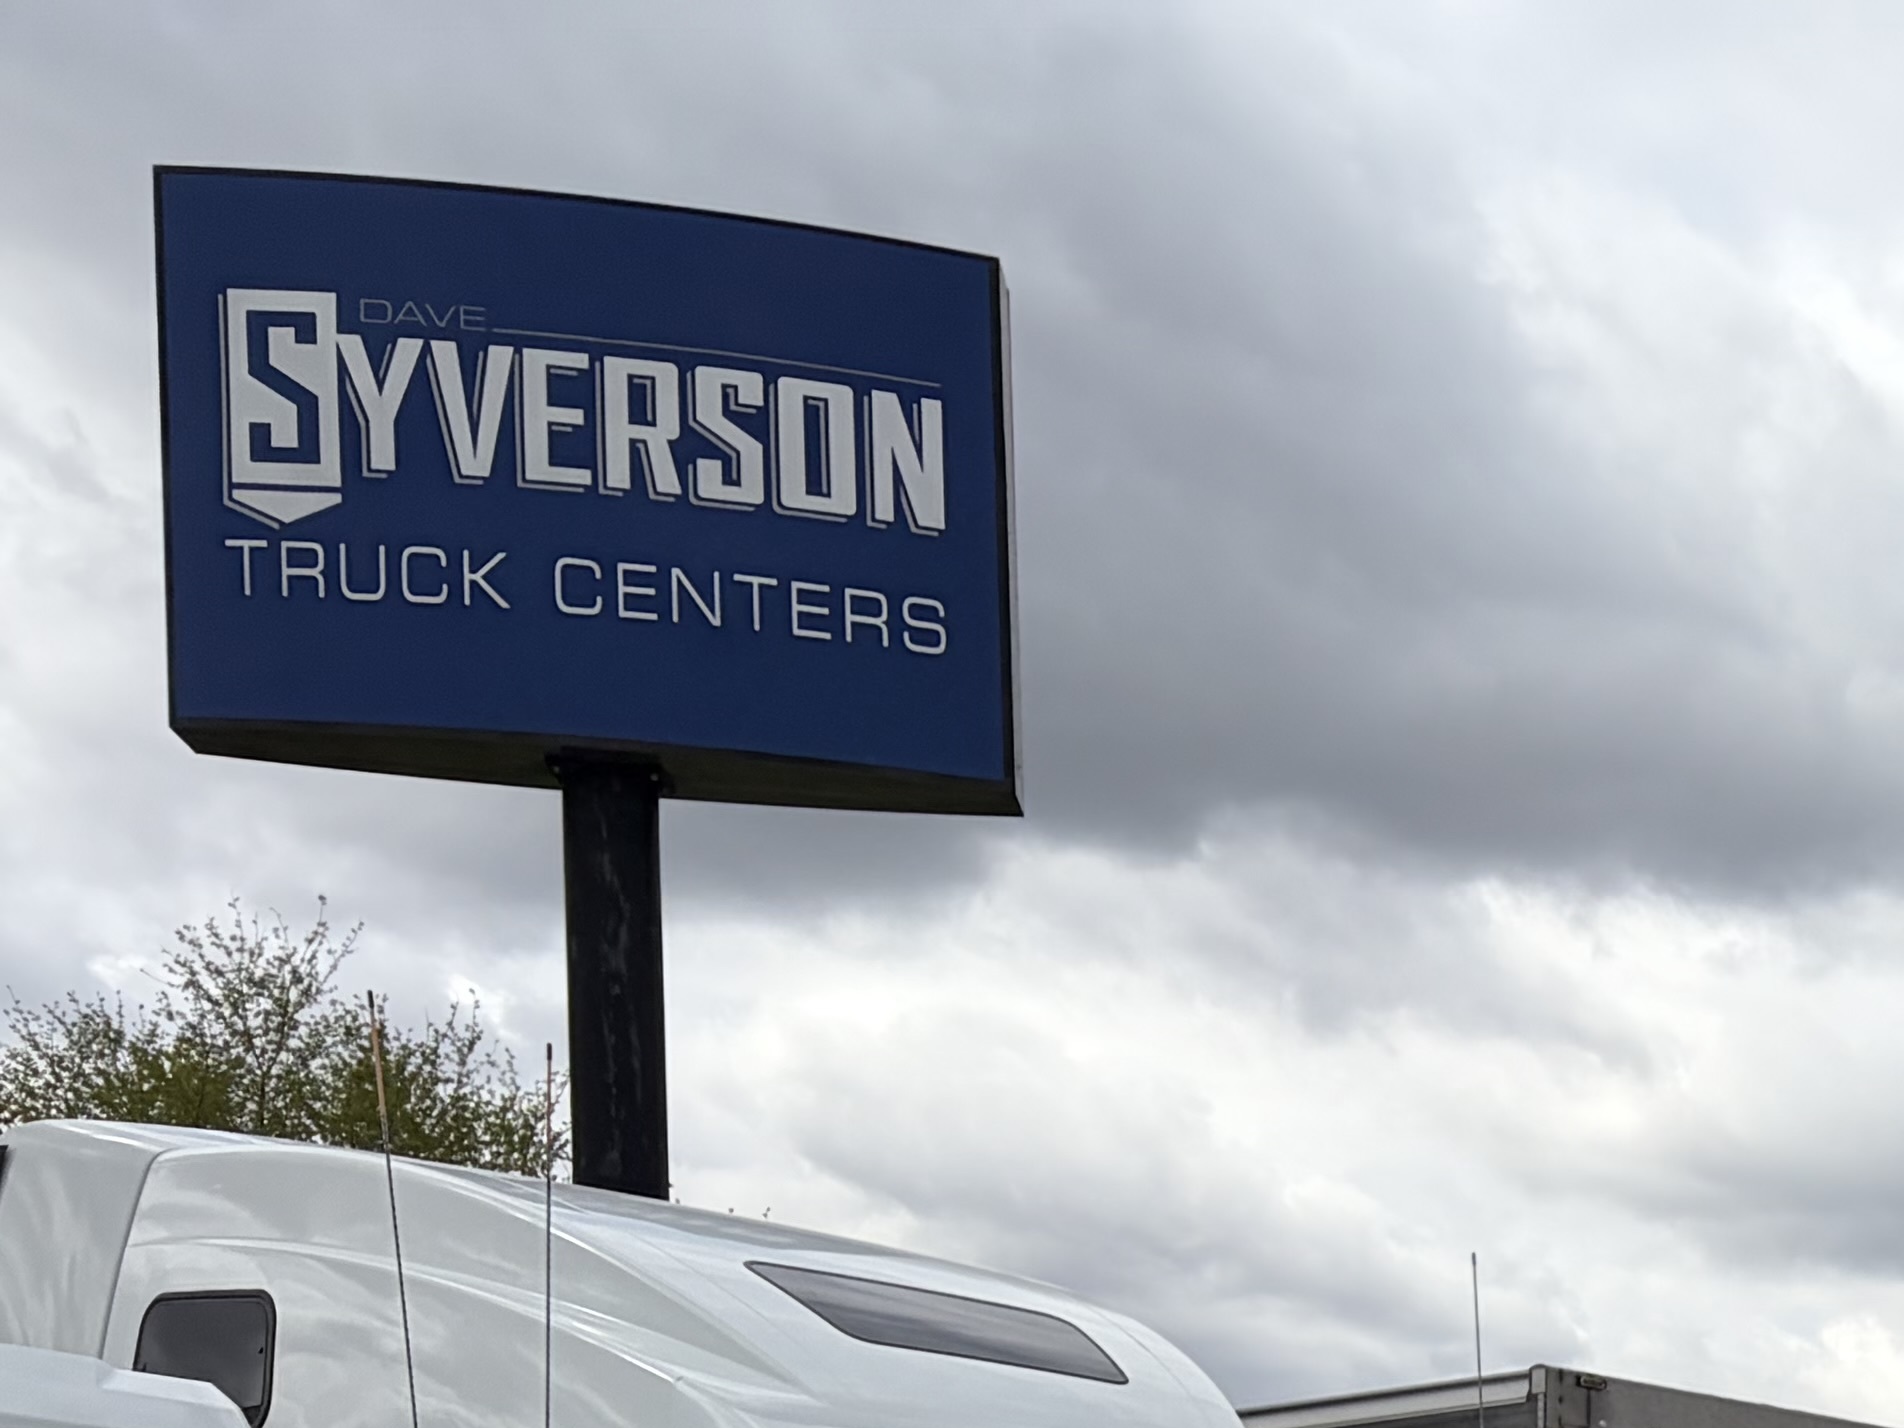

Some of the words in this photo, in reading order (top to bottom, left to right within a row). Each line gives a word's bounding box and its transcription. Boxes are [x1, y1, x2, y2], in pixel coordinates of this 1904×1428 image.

[358, 297, 487, 331] DAVE
[218, 288, 947, 536] SYVERSON
[225, 539, 510, 609] TRUCK
[554, 557, 947, 655] CENTERS
